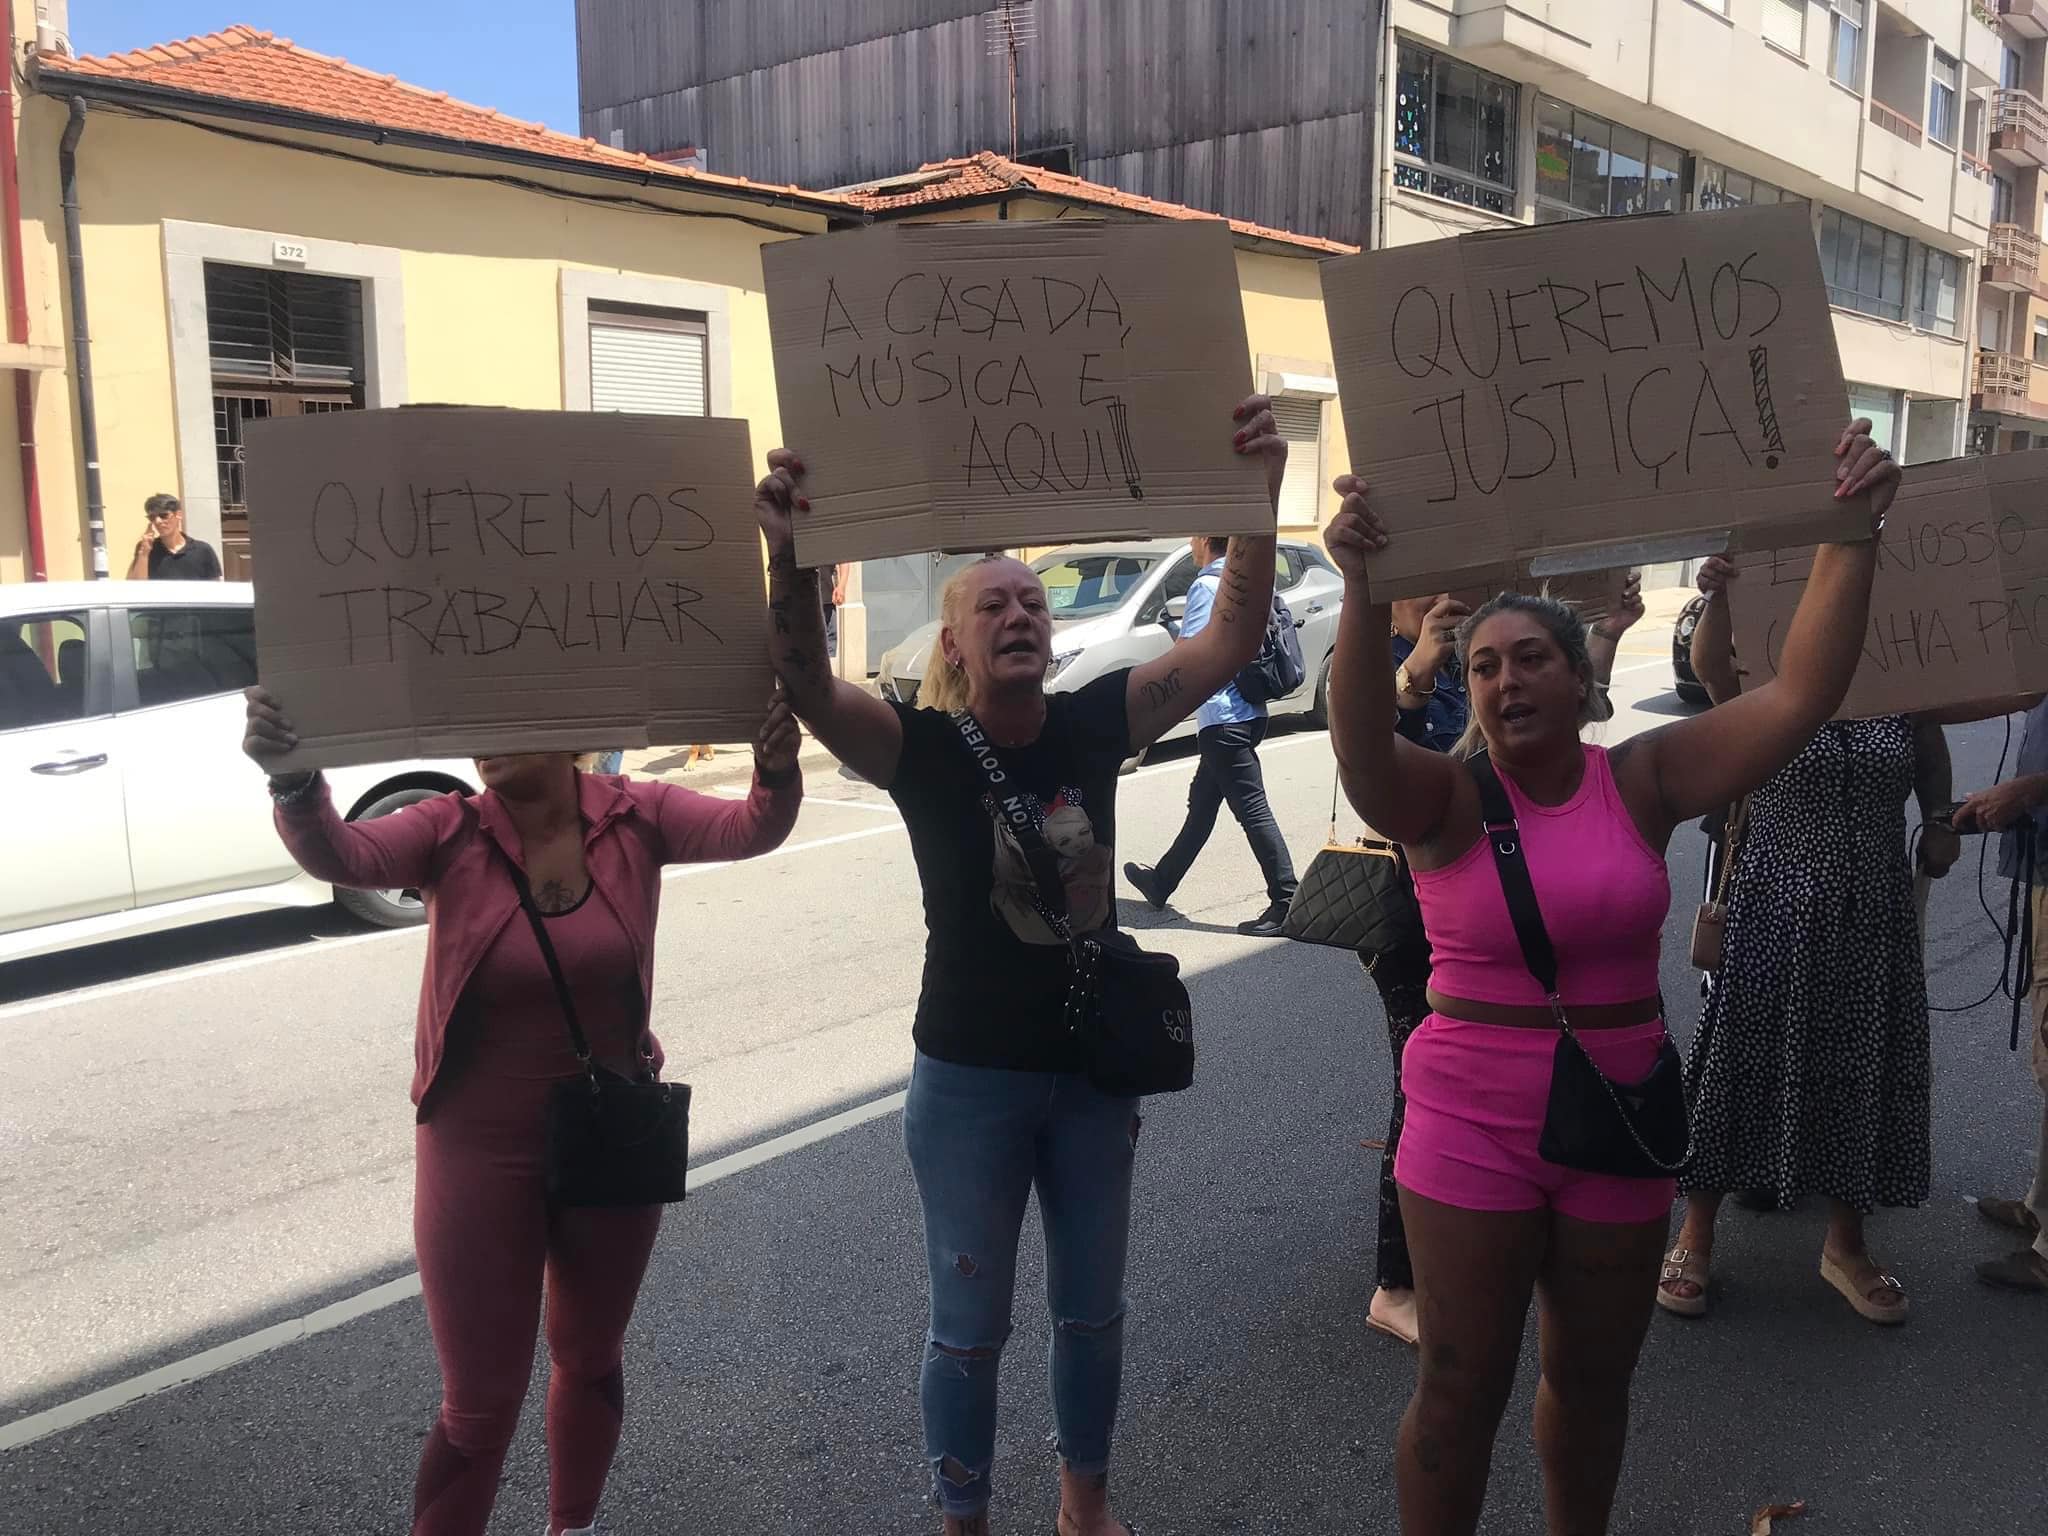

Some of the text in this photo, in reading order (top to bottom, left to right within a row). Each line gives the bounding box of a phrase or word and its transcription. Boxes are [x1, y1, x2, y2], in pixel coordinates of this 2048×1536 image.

[279, 245, 305, 258] 372
[821, 276, 863, 348] A
[884, 272, 1025, 341] CASA
[1391, 251, 1782, 379] QUEREMOS
[825, 343, 1044, 417] MÚSICA
[1412, 344, 1787, 504] JUSTIÇA!
[311, 479, 715, 566] QUEREMOS
[318, 578, 724, 665] TRABALHAR
